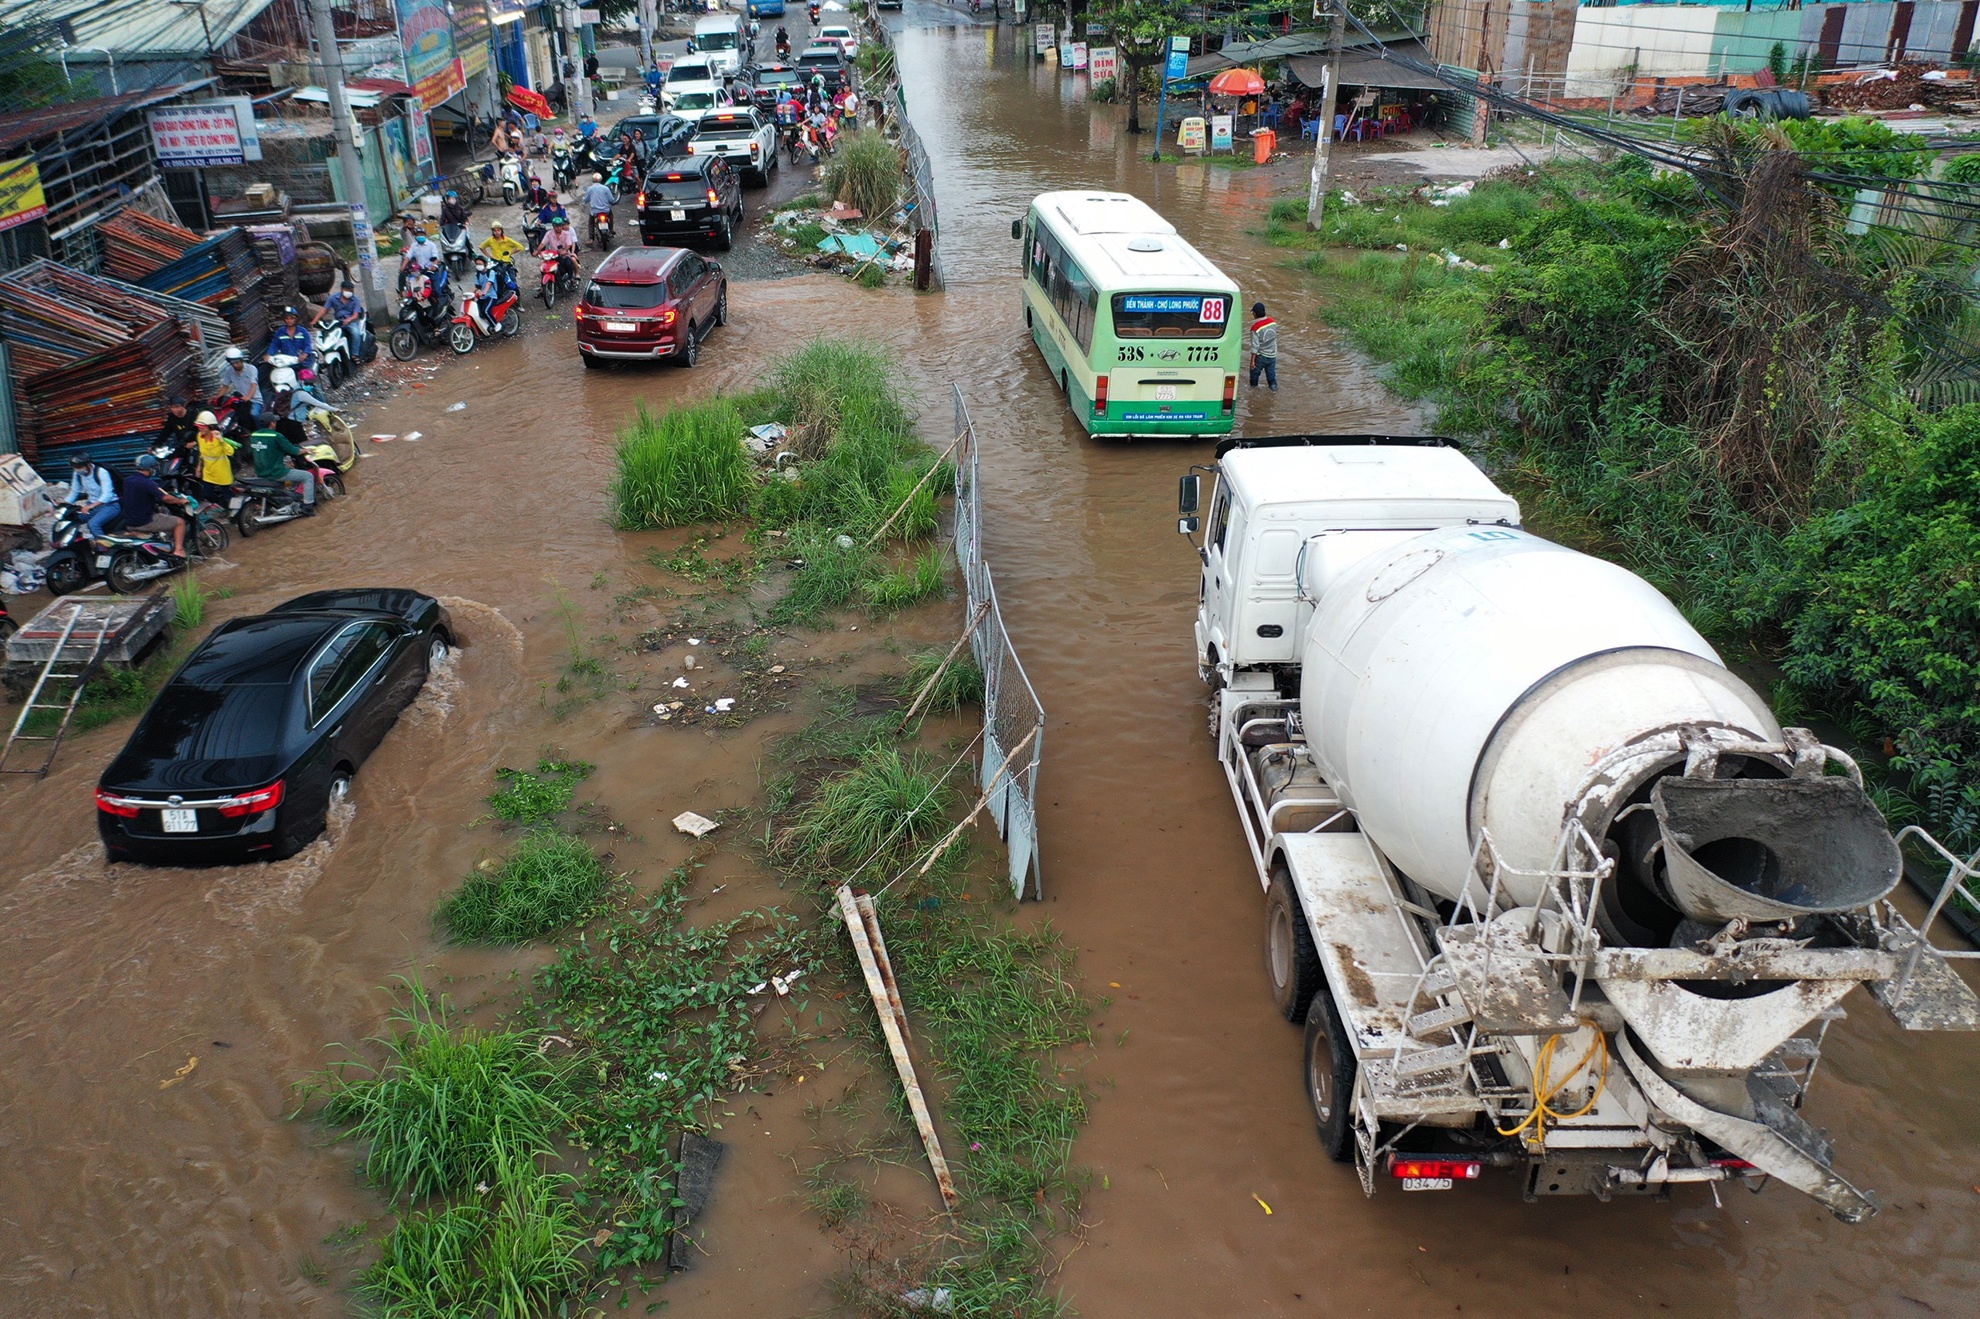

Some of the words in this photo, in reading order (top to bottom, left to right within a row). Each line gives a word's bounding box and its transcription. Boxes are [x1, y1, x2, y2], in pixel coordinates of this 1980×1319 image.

[1126, 297, 1137, 309] BẾN
[1137, 298, 1155, 309] THÀNH
[1157, 299, 1168, 312] CHỢ
[1169, 300, 1182, 309] LONG
[1182, 299, 1200, 310] PHƯỚC
[1203, 300, 1222, 320] 88
[1117, 345, 1144, 361] 53S
[1187, 346, 1219, 362] 7775
